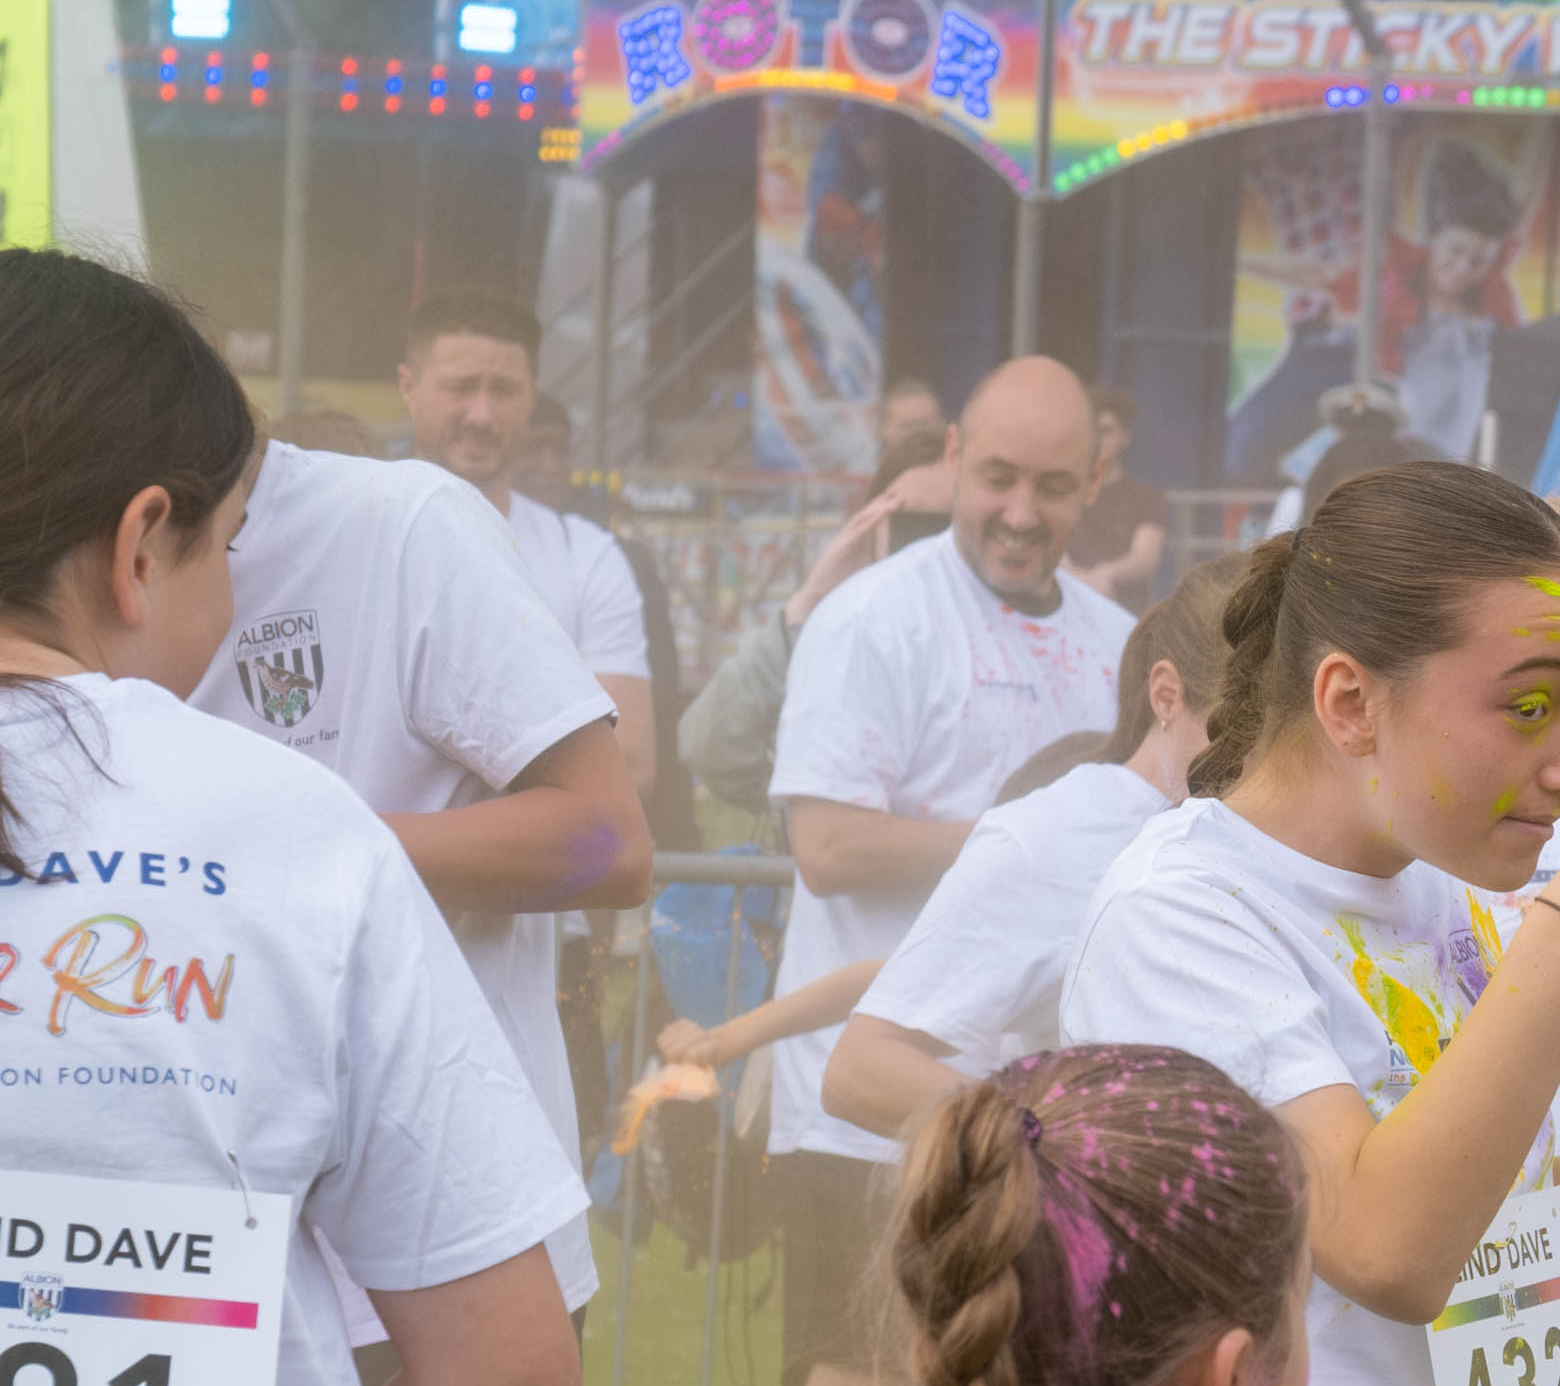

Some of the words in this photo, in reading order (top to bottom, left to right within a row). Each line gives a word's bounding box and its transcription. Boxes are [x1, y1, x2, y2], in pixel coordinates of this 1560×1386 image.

[1082, 0, 1227, 68] THE
[238, 613, 314, 647] ALBION
[295, 735, 316, 747] our
[57, 1065, 238, 1097] FOUNDATION
[65, 1223, 215, 1275] DAVE
[1507, 1226, 1554, 1271] DAVE
